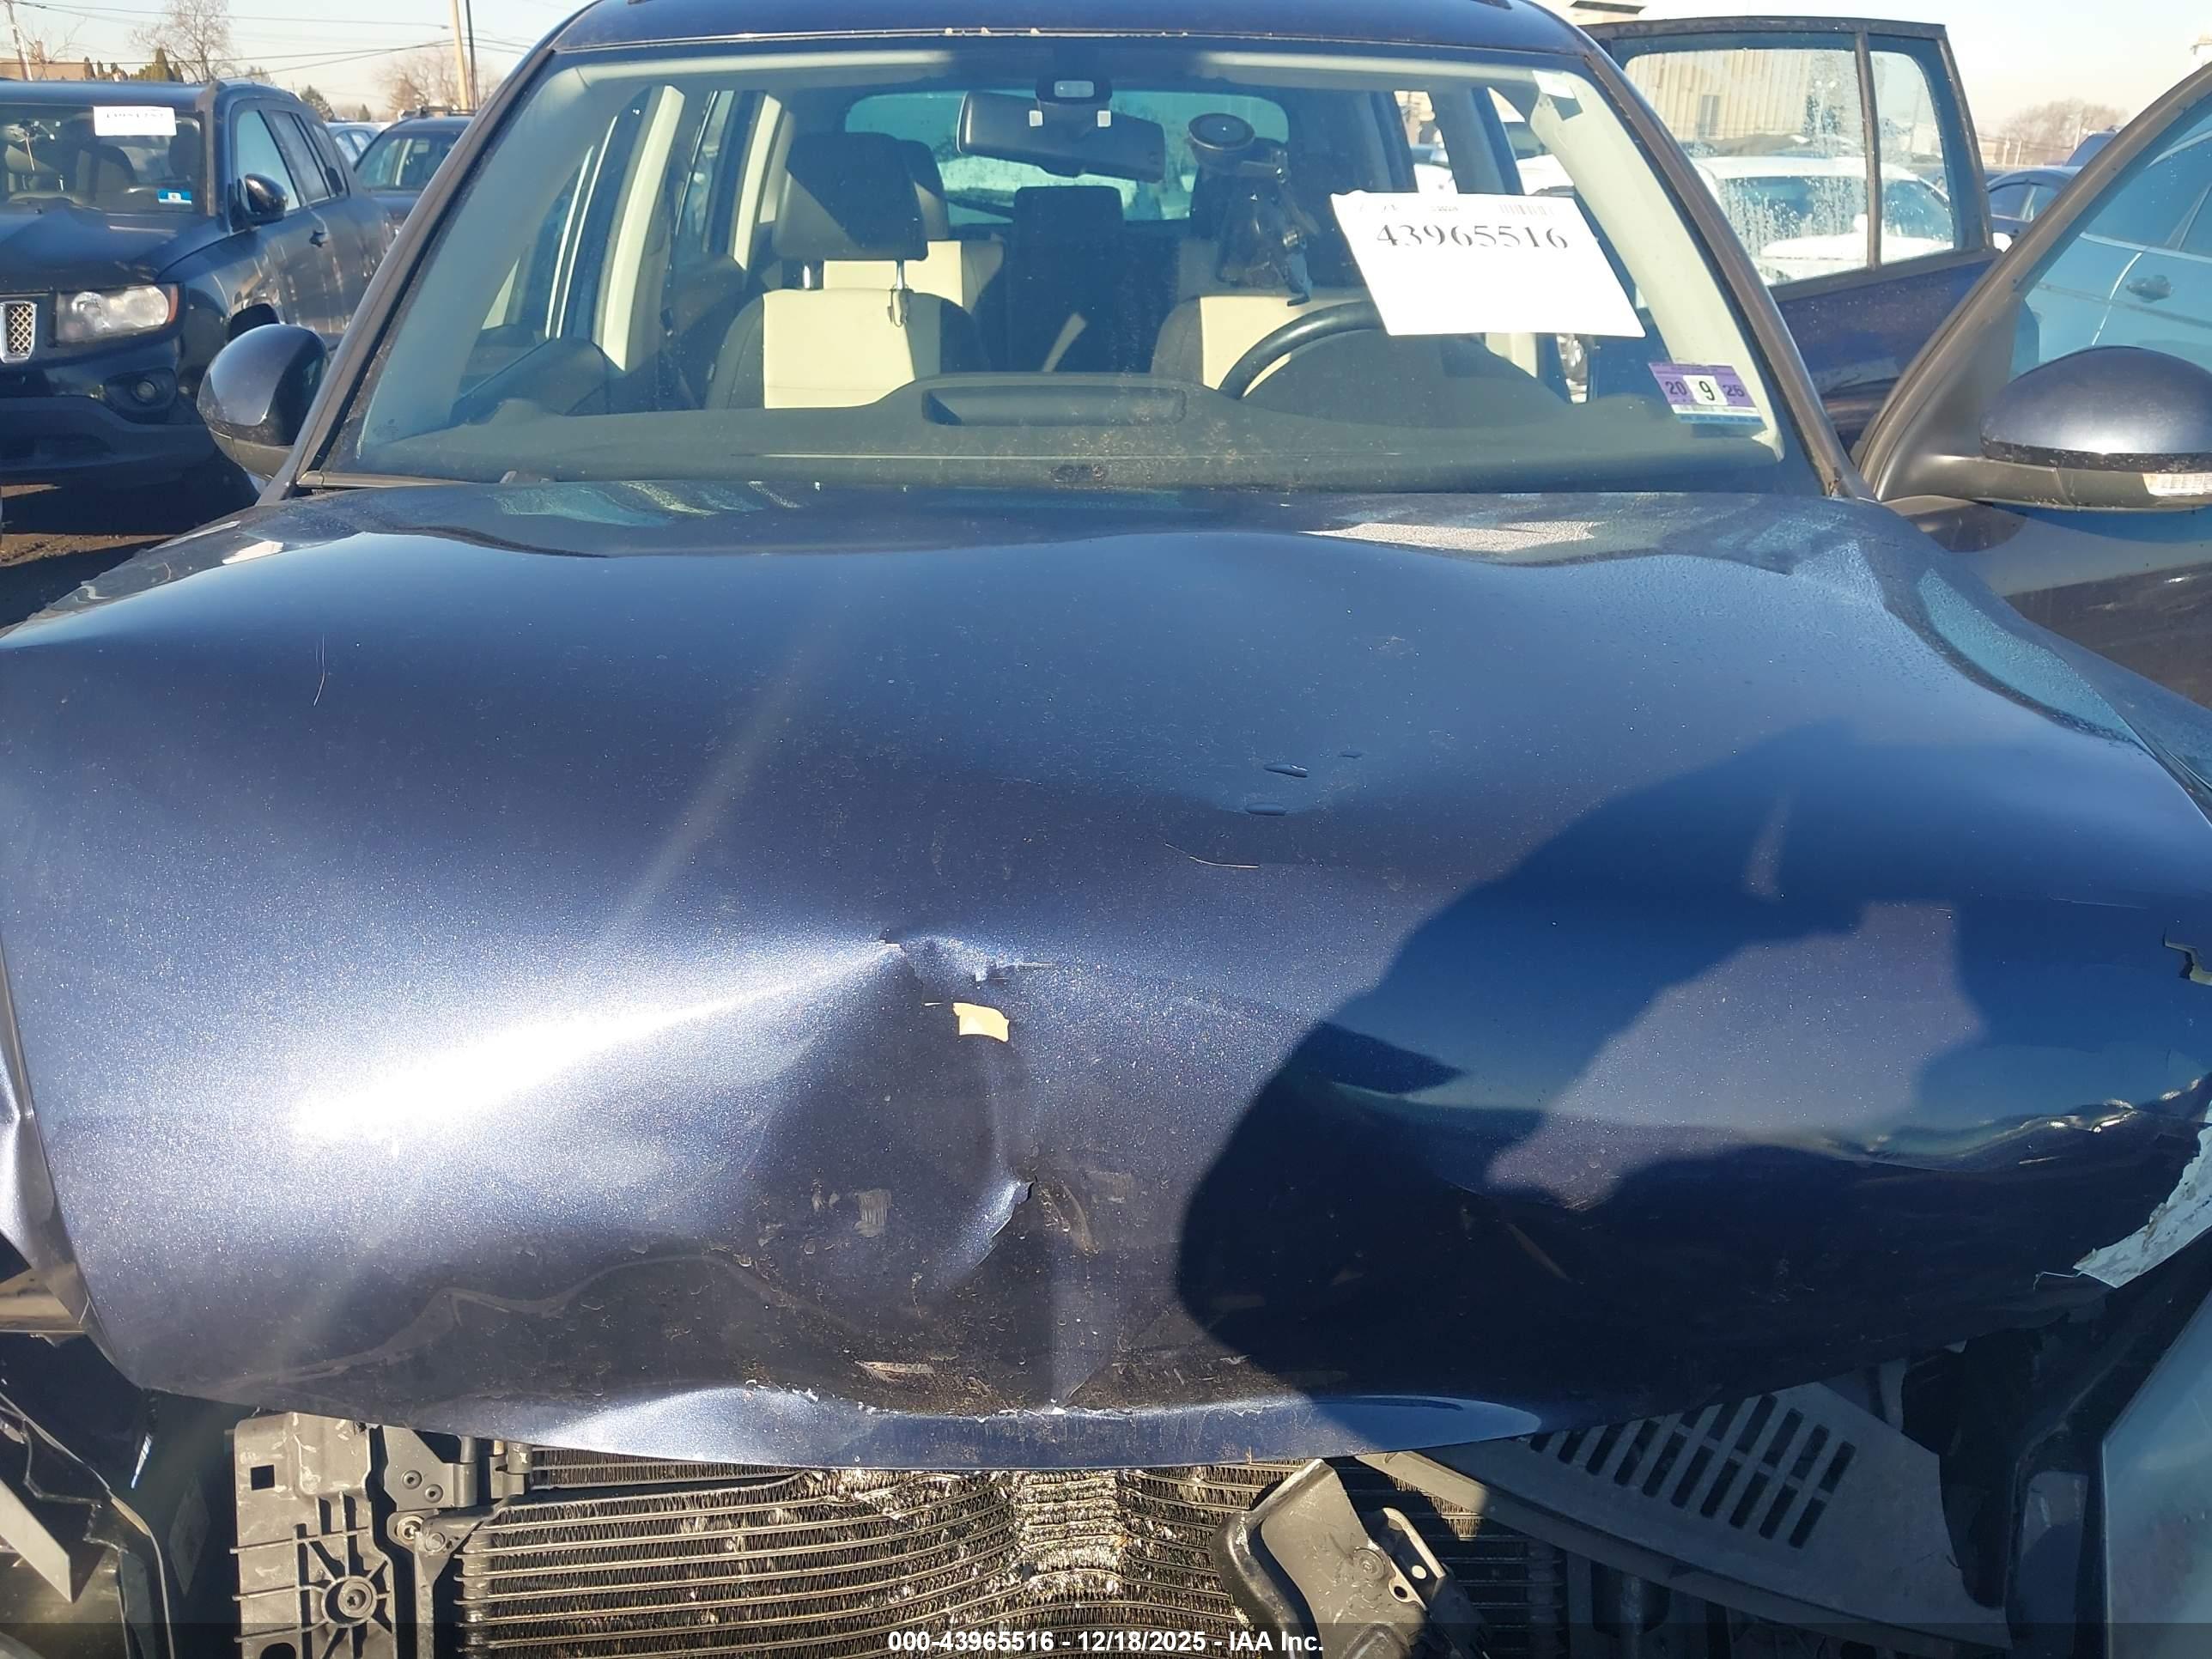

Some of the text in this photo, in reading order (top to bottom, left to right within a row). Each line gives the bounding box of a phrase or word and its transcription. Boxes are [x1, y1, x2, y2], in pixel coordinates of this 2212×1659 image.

[1376, 223, 1569, 249] 43965516
[1665, 380, 1687, 396] 20
[1698, 380, 1716, 401] 9
